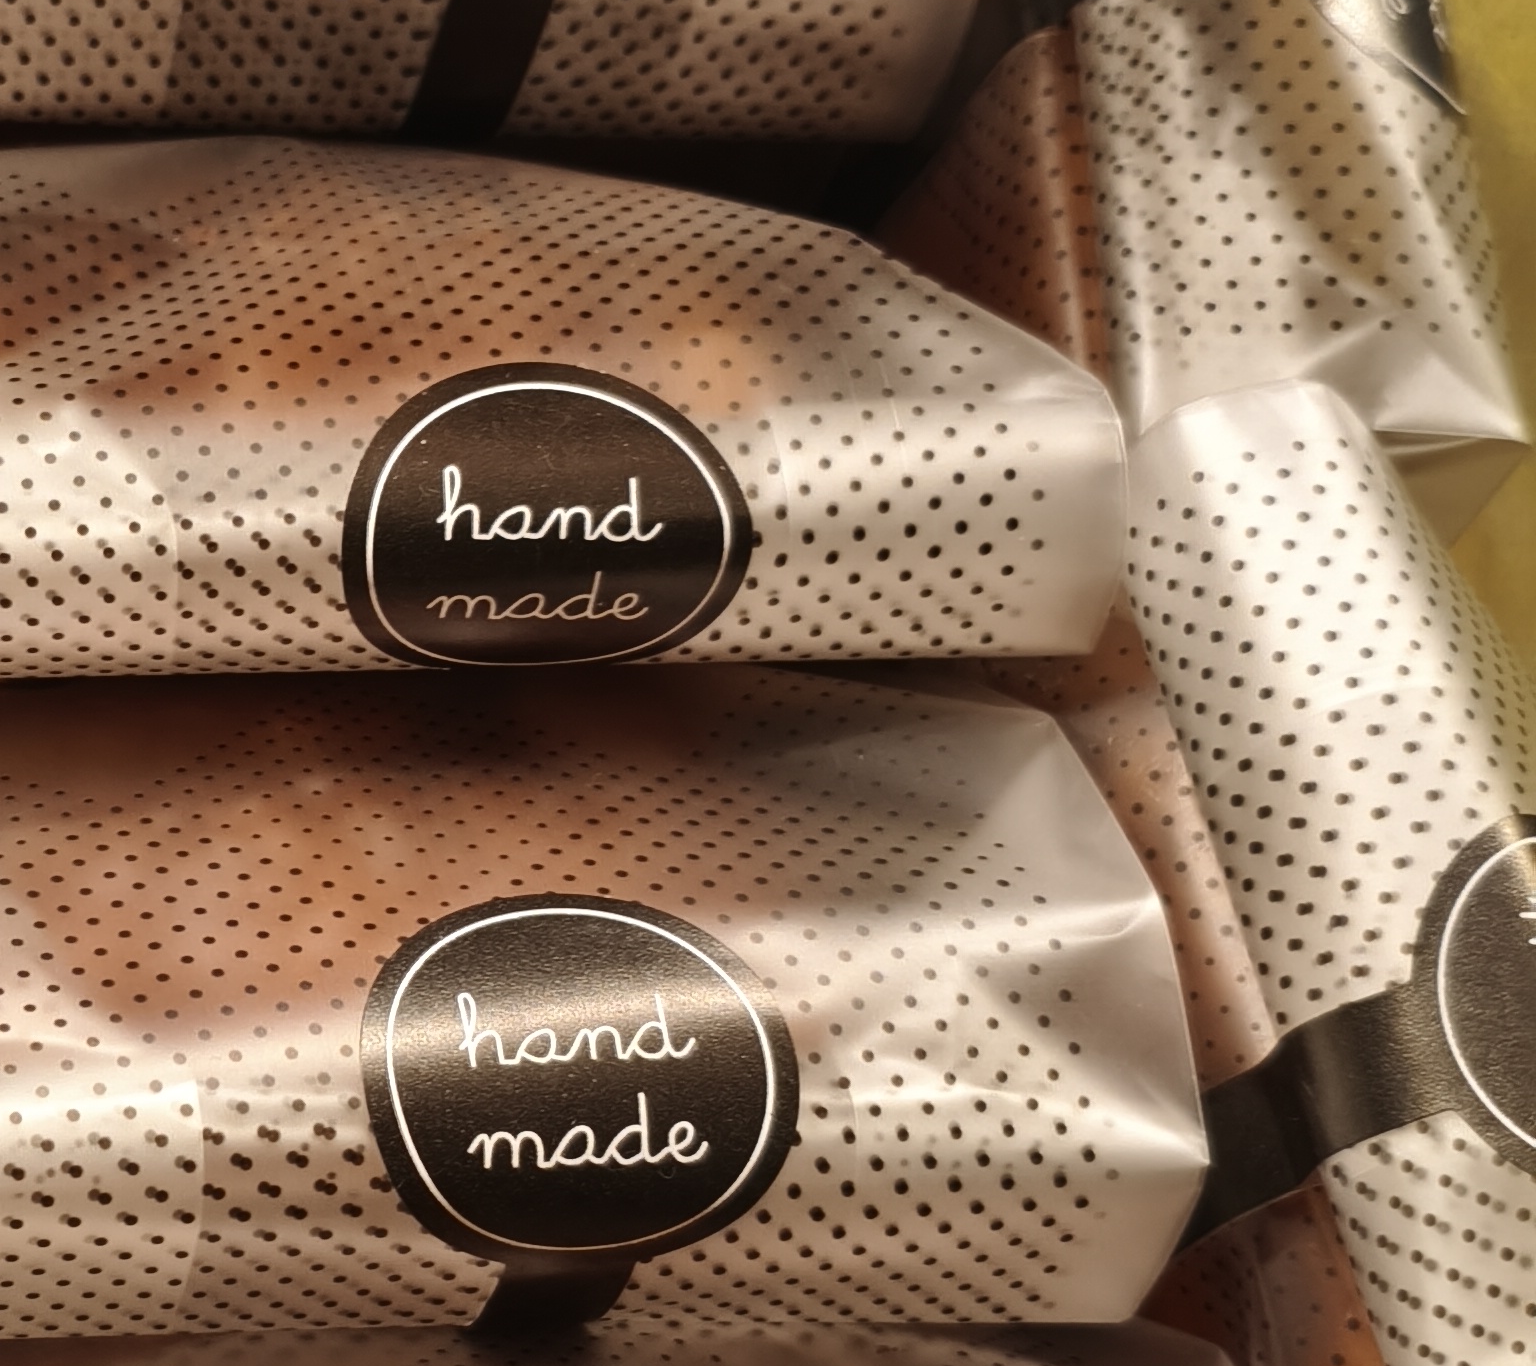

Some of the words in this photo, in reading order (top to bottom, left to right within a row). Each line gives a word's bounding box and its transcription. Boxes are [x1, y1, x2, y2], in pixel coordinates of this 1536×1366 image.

[435, 464, 664, 543] hand
[425, 570, 650, 621] made
[456, 992, 696, 1068] hand
[466, 1091, 709, 1170] made
